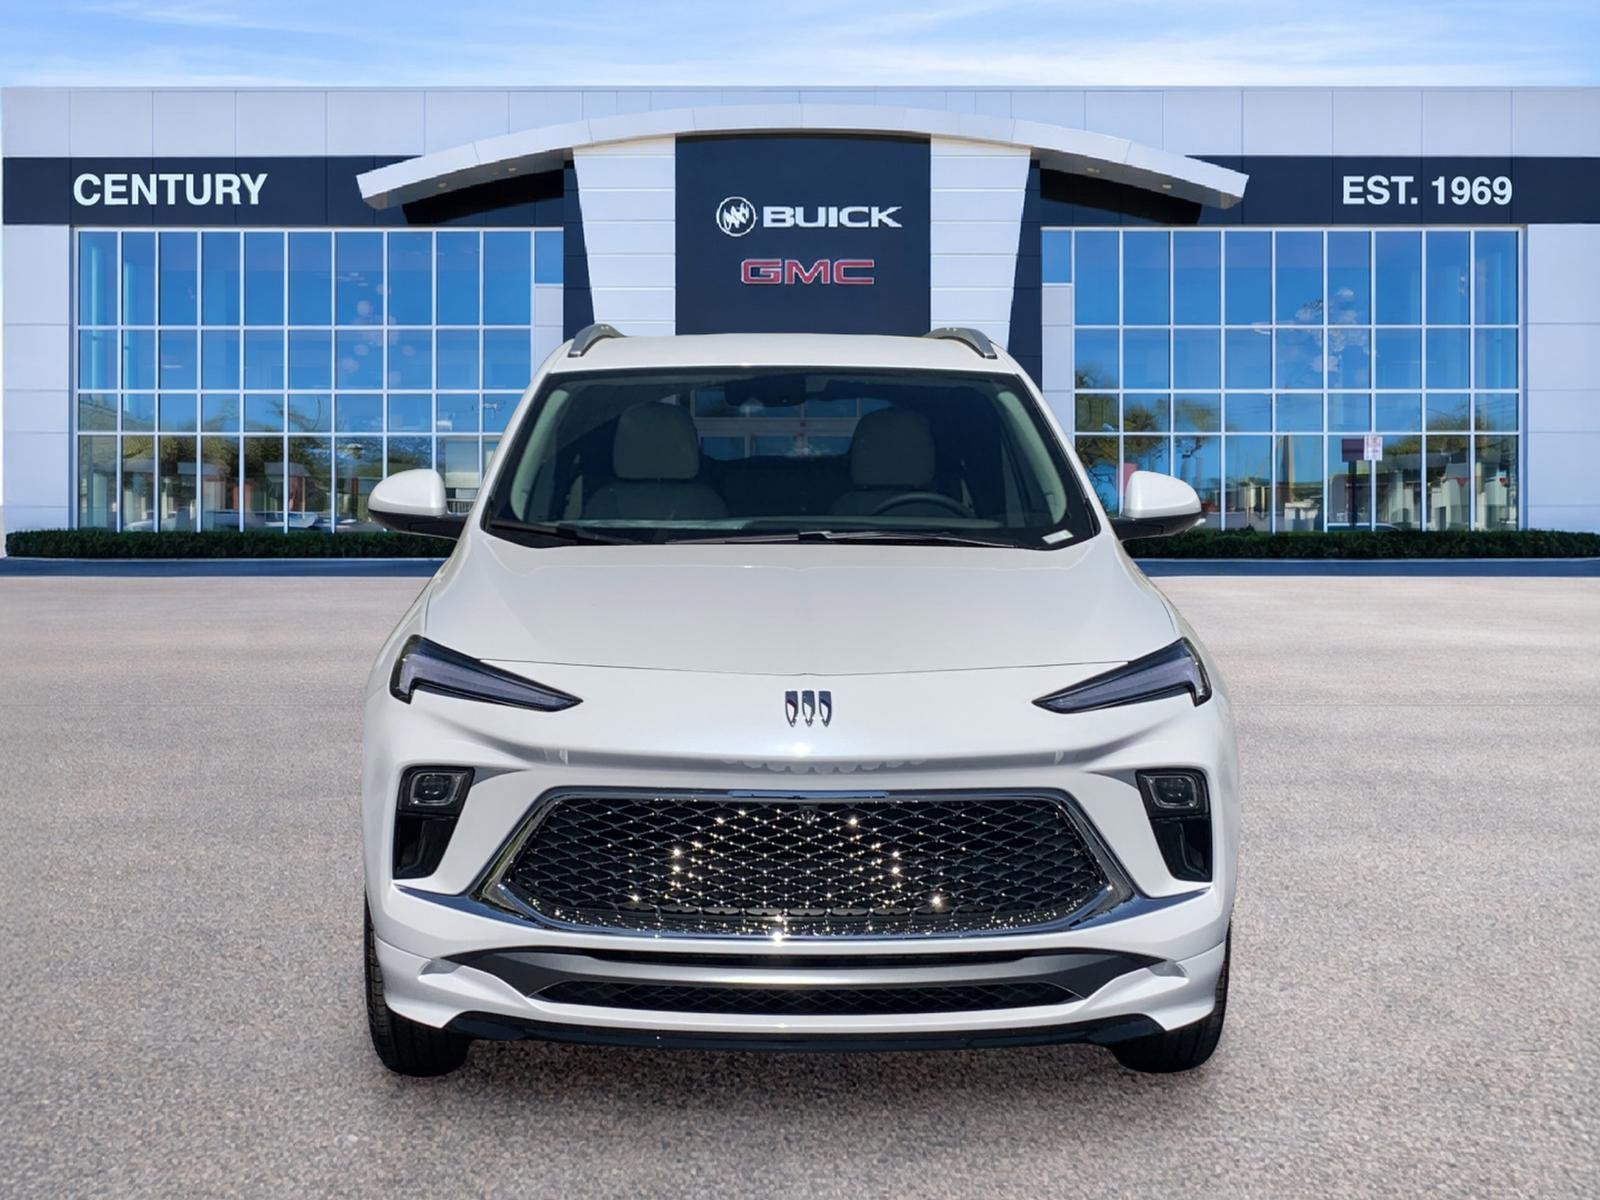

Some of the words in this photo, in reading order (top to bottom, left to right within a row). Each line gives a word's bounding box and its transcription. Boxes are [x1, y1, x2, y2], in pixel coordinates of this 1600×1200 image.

[73, 172, 268, 206] CENTURY
[1342, 175, 1418, 205] EST.
[1431, 175, 1513, 206] 1969
[763, 205, 902, 228] BUICK
[741, 258, 875, 285] GMC
